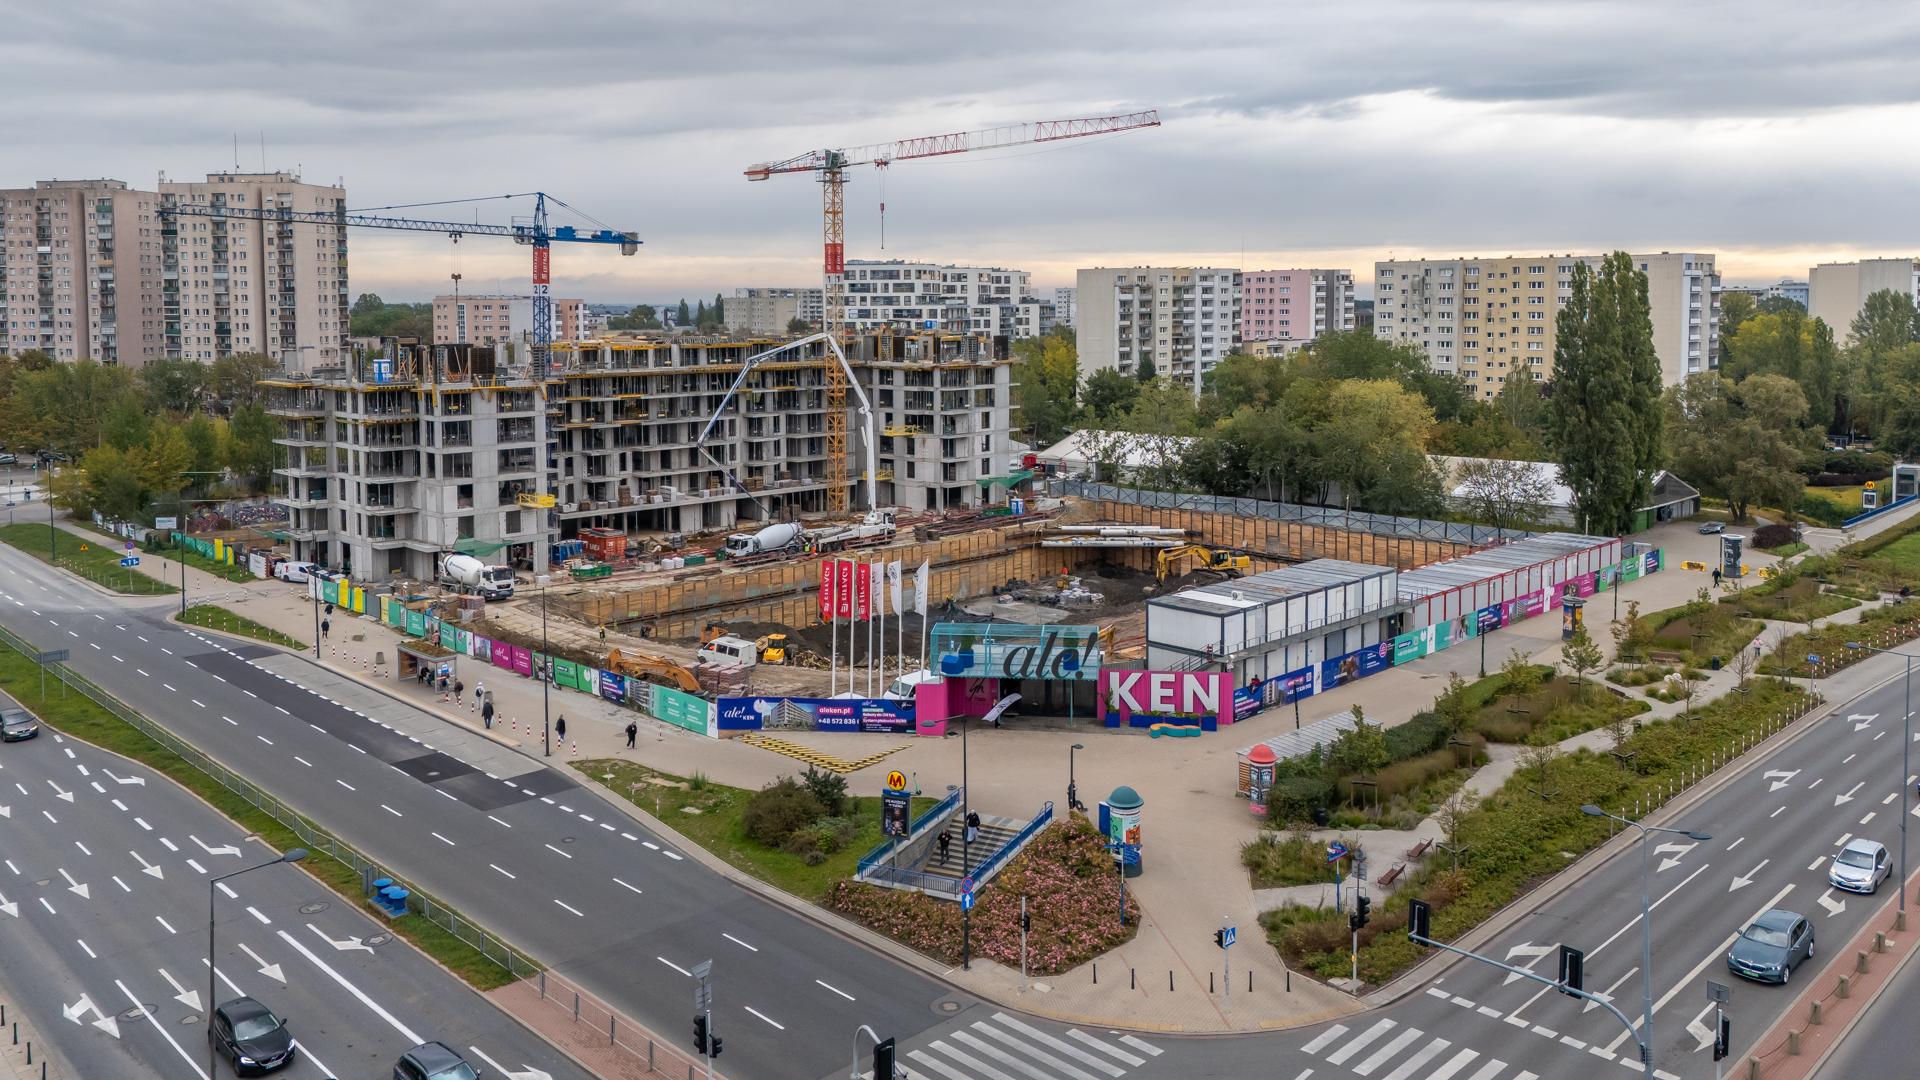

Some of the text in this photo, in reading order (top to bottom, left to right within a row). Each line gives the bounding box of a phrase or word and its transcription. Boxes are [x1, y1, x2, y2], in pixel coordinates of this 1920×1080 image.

[534, 285, 538, 294] 2
[542, 285, 548, 294] 2
[1002, 631, 1098, 680] ale!
[1109, 671, 1220, 714] KEN
[723, 706, 745, 719] ale!
[819, 707, 850, 715] aleken.pl
[889, 774, 902, 788] M
